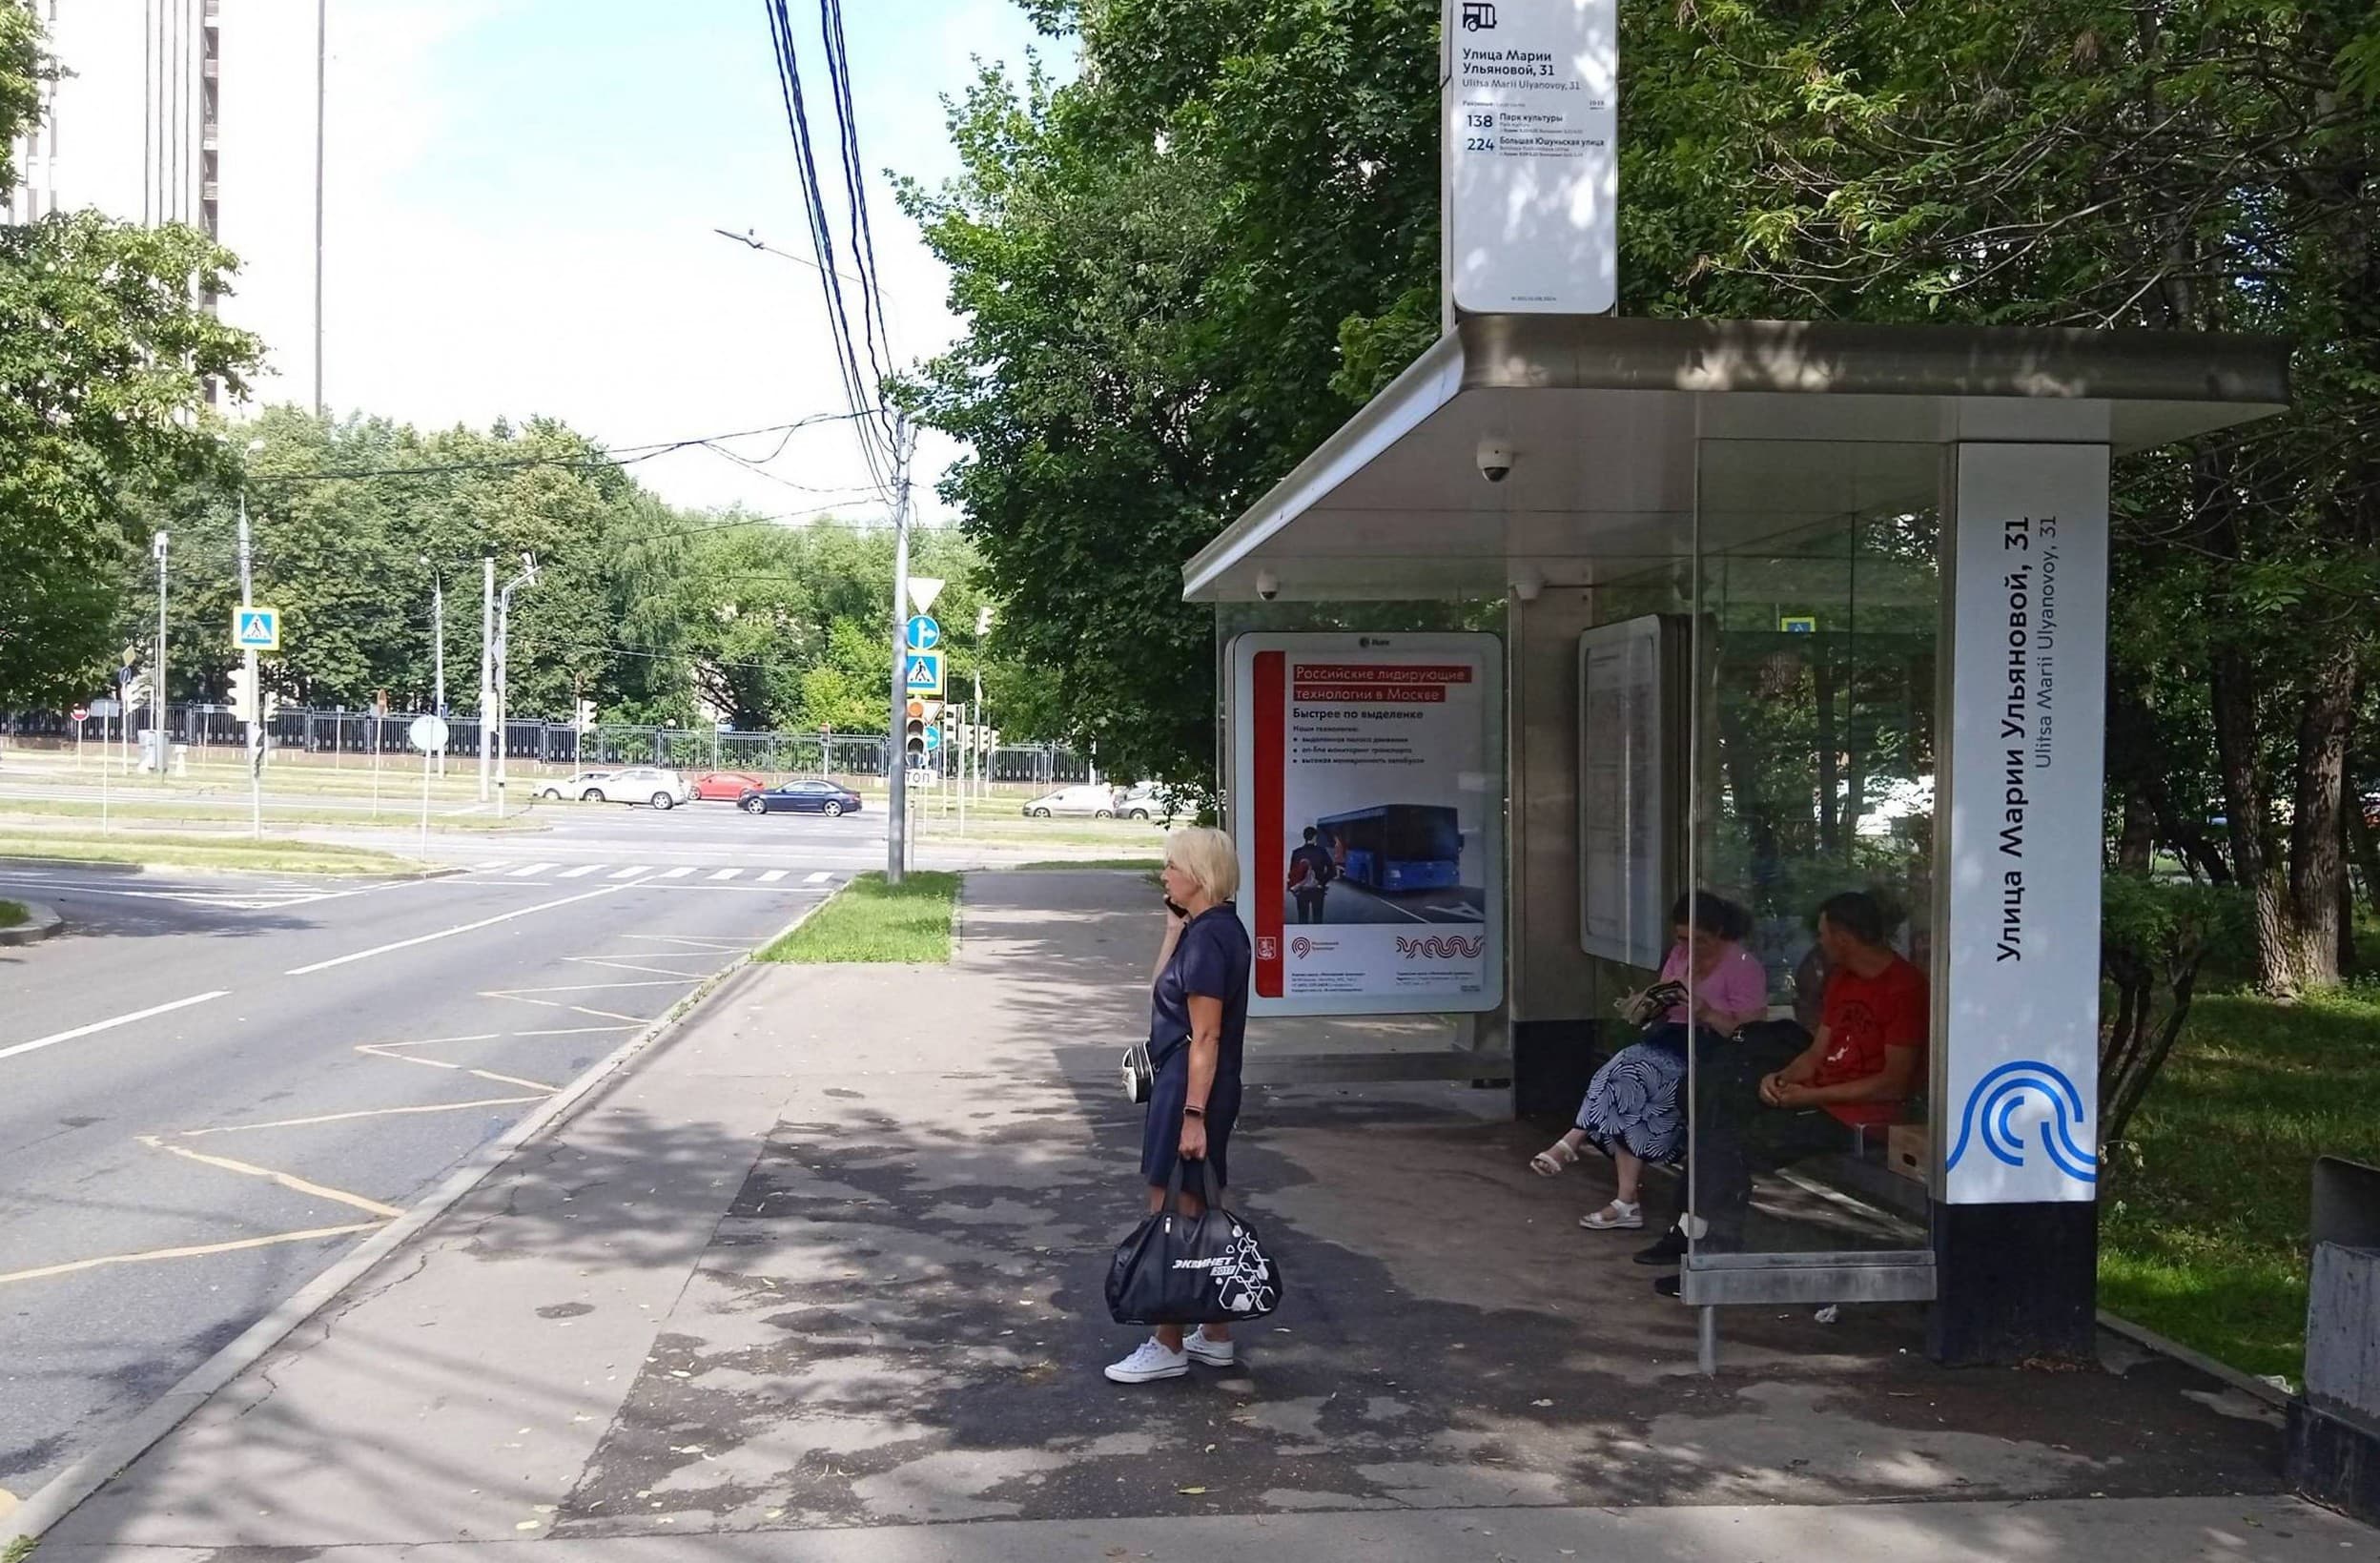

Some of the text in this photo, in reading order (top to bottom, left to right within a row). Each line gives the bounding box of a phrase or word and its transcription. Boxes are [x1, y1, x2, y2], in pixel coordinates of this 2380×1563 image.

[1463, 48, 1551, 63] Улица Марии
[1463, 62, 1554, 76] Ульяновой, 31
[1463, 78, 1581, 91] Ulitsa Marii Ulyanovoy, 31
[1467, 114, 1493, 128] 138
[1500, 113, 1521, 122] Парк
[1523, 114, 1564, 123] культуры
[1467, 137, 1495, 152] 224
[2034, 516, 2060, 769] Ulitsa Marii Ulyanovoy, 31
[1296, 667, 1466, 682] Российские лидирующие
[1296, 689, 1441, 701] технологии в Москве
[1293, 708, 1340, 720] Быстрее
[1344, 710, 1358, 719] по
[1996, 516, 2033, 962] Улица Марии Ульяновой, 31
[905, 771, 930, 783] ТОП
